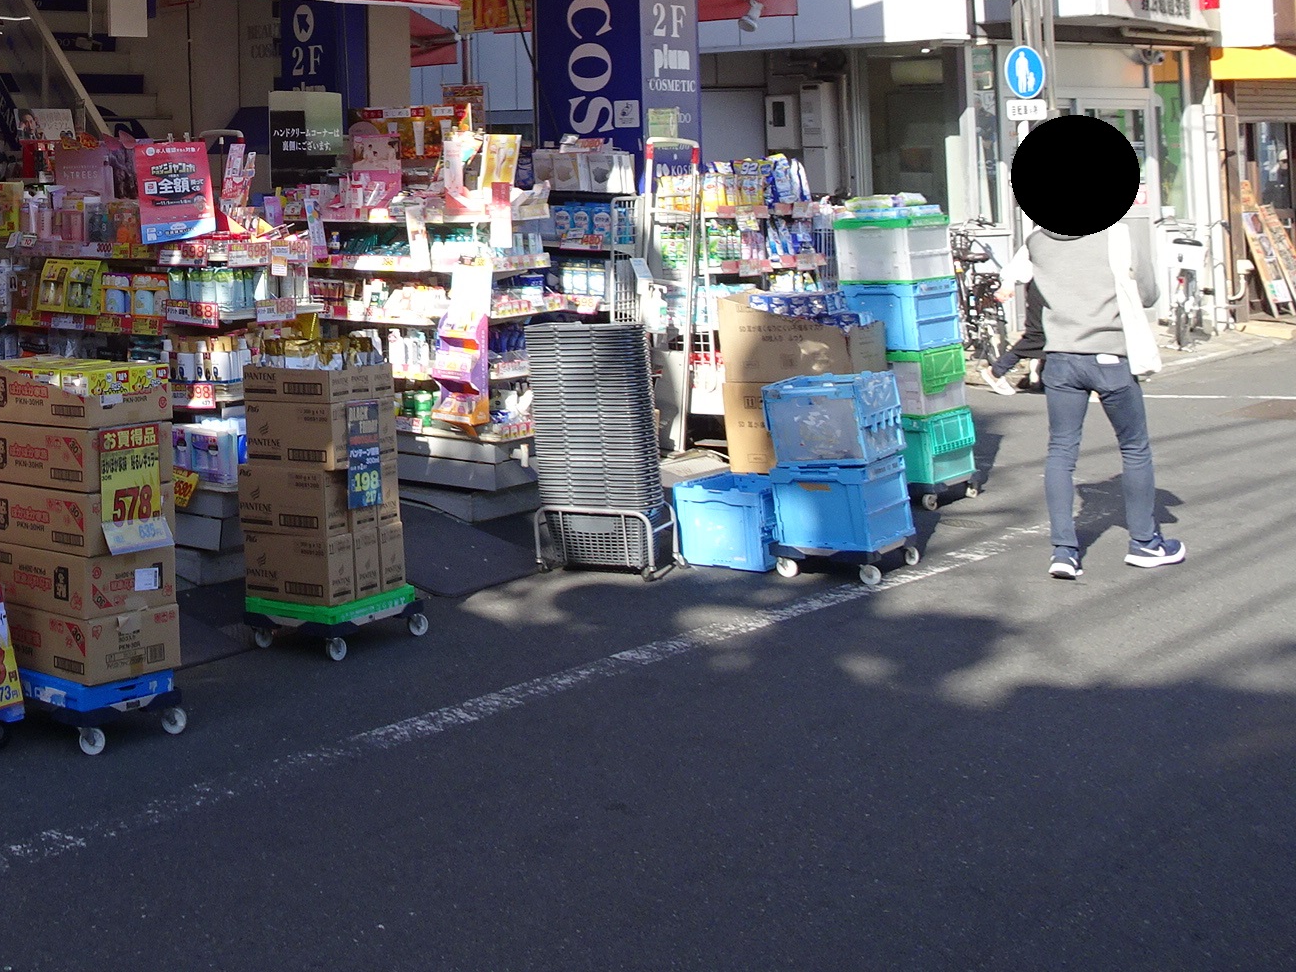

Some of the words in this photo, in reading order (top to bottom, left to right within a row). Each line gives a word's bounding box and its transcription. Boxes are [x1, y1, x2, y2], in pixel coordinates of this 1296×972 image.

[652, 3, 687, 39] 2F
[291, 44, 324, 77] 2F
[647, 78, 696, 93] COSMETIC
[272, 127, 340, 138] ハンドクリームコーナーは
[158, 177, 191, 194] 全額
[181, 244, 205, 259] 598
[247, 244, 268, 258] 598
[190, 303, 213, 318] 188
[244, 372, 276, 382] PANTENE
[103, 427, 157, 450] お買得品
[248, 437, 281, 448] PANTENE
[355, 470, 380, 492] 198
[113, 484, 152, 528] 578
[239, 502, 272, 513] PANTENE
[246, 568, 277, 580] PANTENE
